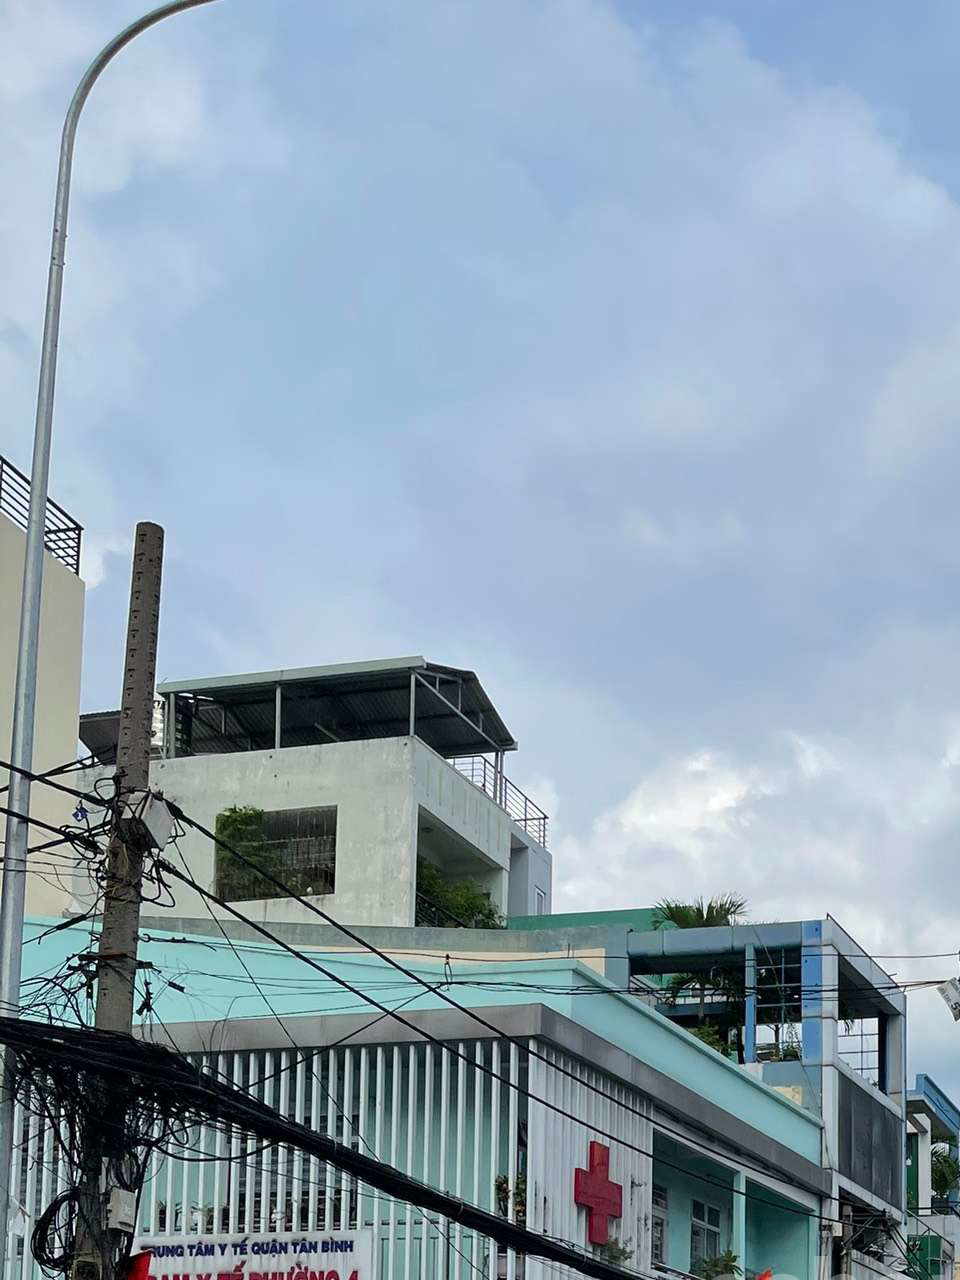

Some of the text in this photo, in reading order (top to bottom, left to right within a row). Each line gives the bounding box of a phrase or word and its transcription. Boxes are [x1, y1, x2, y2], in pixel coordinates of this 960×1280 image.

[187, 1241, 215, 1257] TÂM
[218, 1243, 228, 1257] Y
[231, 1237, 248, 1256] TẾ
[251, 1239, 288, 1258] QUẬN
[291, 1238, 318, 1255] TÂN
[321, 1237, 354, 1253] BÌNH
